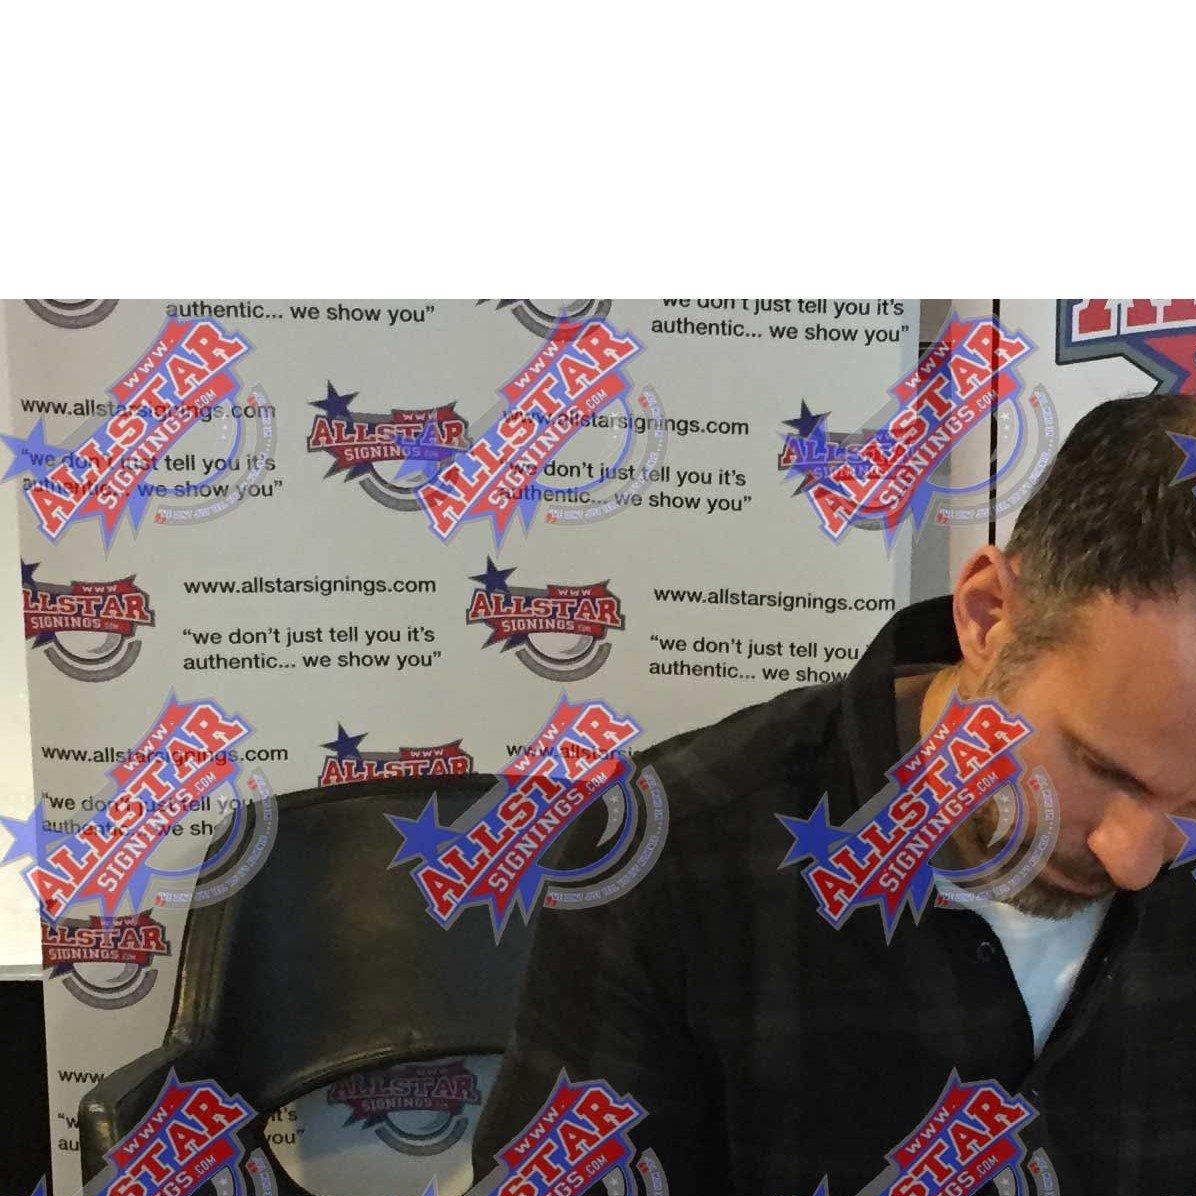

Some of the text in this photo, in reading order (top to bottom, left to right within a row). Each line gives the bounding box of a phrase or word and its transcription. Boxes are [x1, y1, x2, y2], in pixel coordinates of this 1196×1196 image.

[166, 300, 283, 319] authentic...
[290, 306, 320, 320] we
[327, 304, 381, 322] show
[833, 301, 870, 319] you
[651, 318, 762, 338] authentic...
[769, 325, 798, 340] we
[805, 324, 858, 342] show
[310, 417, 474, 451] ALLSTAR
[165, 454, 195, 471] tell
[202, 458, 240, 476] you
[344, 446, 421, 462] SIGNINGS
[543, 460, 746, 488] don't just tell you it's
[138, 484, 168, 498] we
[175, 481, 229, 498] show
[614, 491, 643, 506] we
[649, 490, 701, 510] show
[183, 576, 436, 596] www.allstarsignings.com
[22, 588, 151, 623] LLSTAR
[469, 591, 622, 628] ALLSTAR
[654, 588, 896, 614] www.allstarsignings.com
[31, 616, 101, 630] SIGNINGS
[502, 618, 575, 632] SIGNINGS
[183, 626, 435, 647] “we don't just tell you it's
[650, 635, 859, 662] “we don't just tell you
[183, 653, 296, 670] authentic...
[303, 655, 331, 668] we
[338, 651, 390, 668] show
[649, 660, 850, 683] authentic... we show
[322, 756, 471, 788] ALLSTAR
[42, 922, 168, 954] LLSTAR
[48, 948, 120, 960] SIGNINGS
